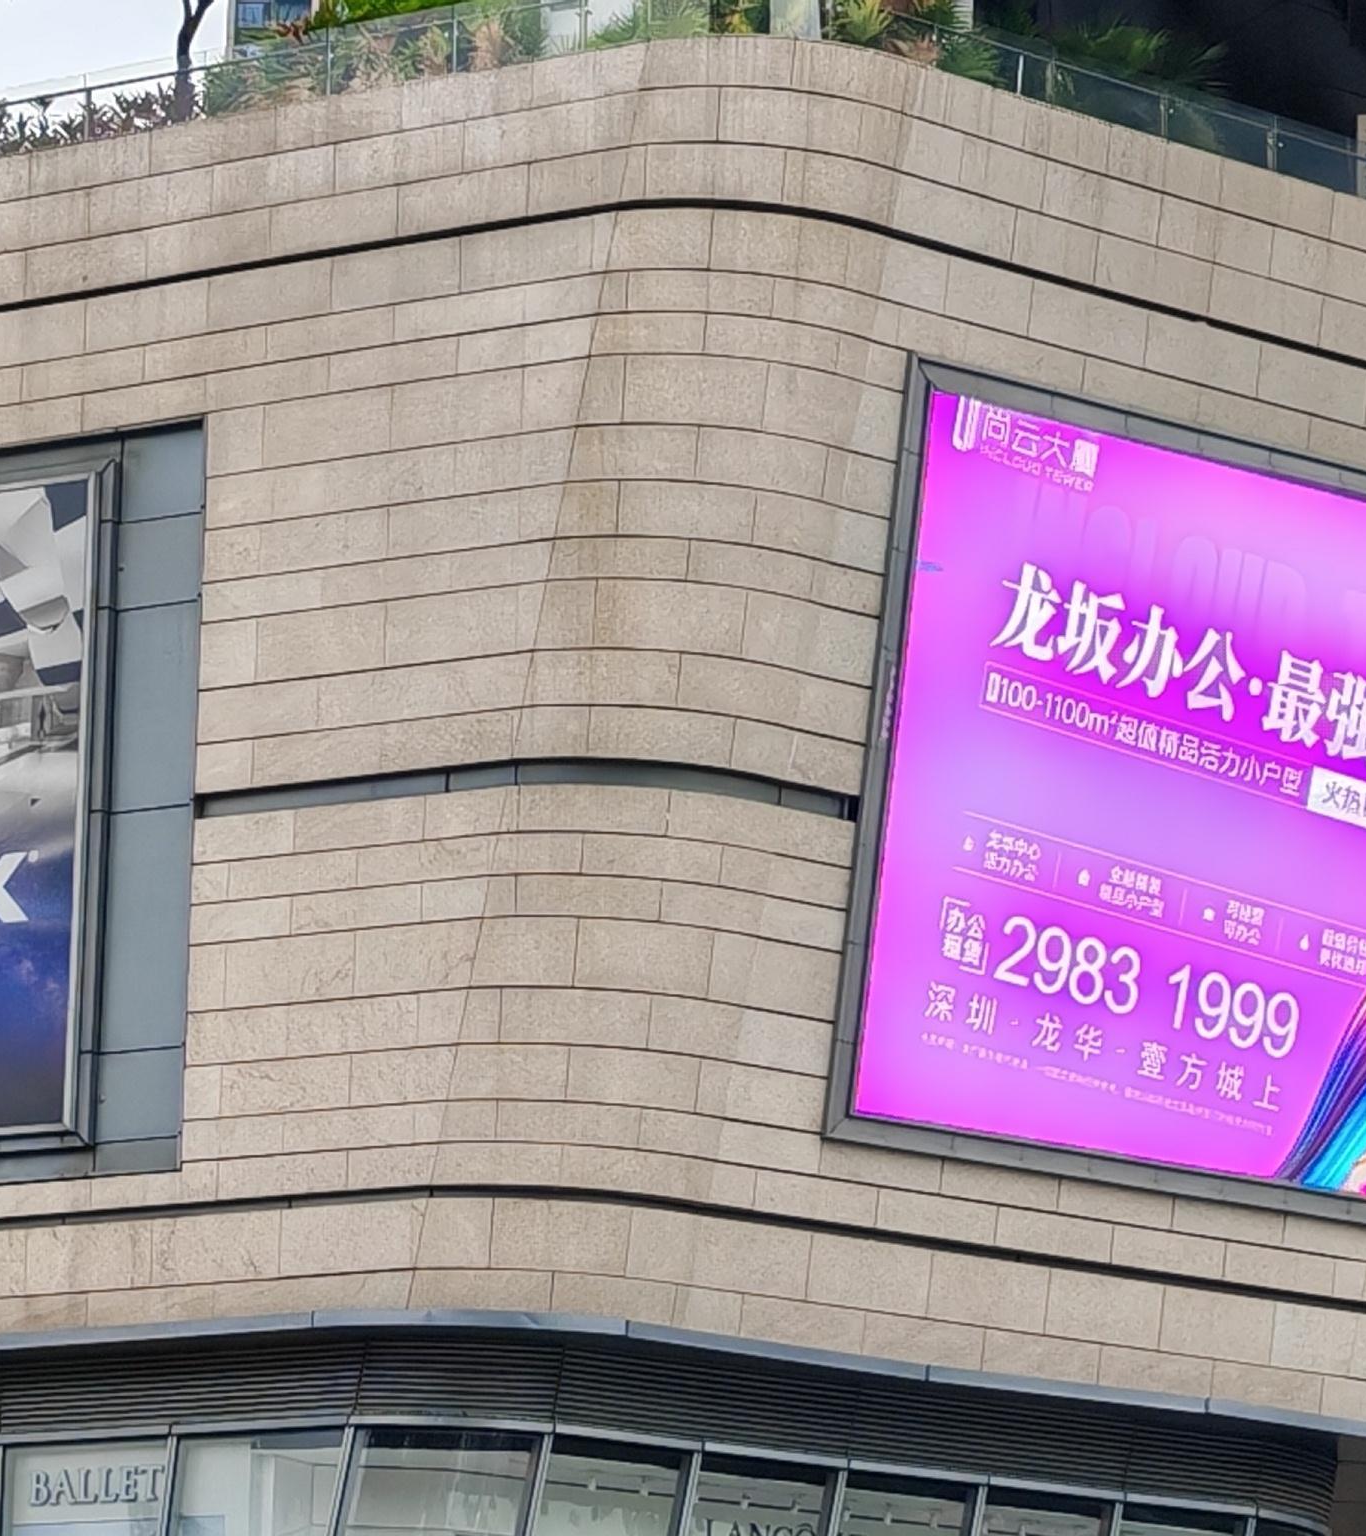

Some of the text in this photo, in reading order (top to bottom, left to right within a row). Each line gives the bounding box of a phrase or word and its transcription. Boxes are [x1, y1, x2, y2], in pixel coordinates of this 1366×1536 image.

[993, 916, 1301, 1059] 2983 1999
[28, 1463, 167, 1507] BALLET
